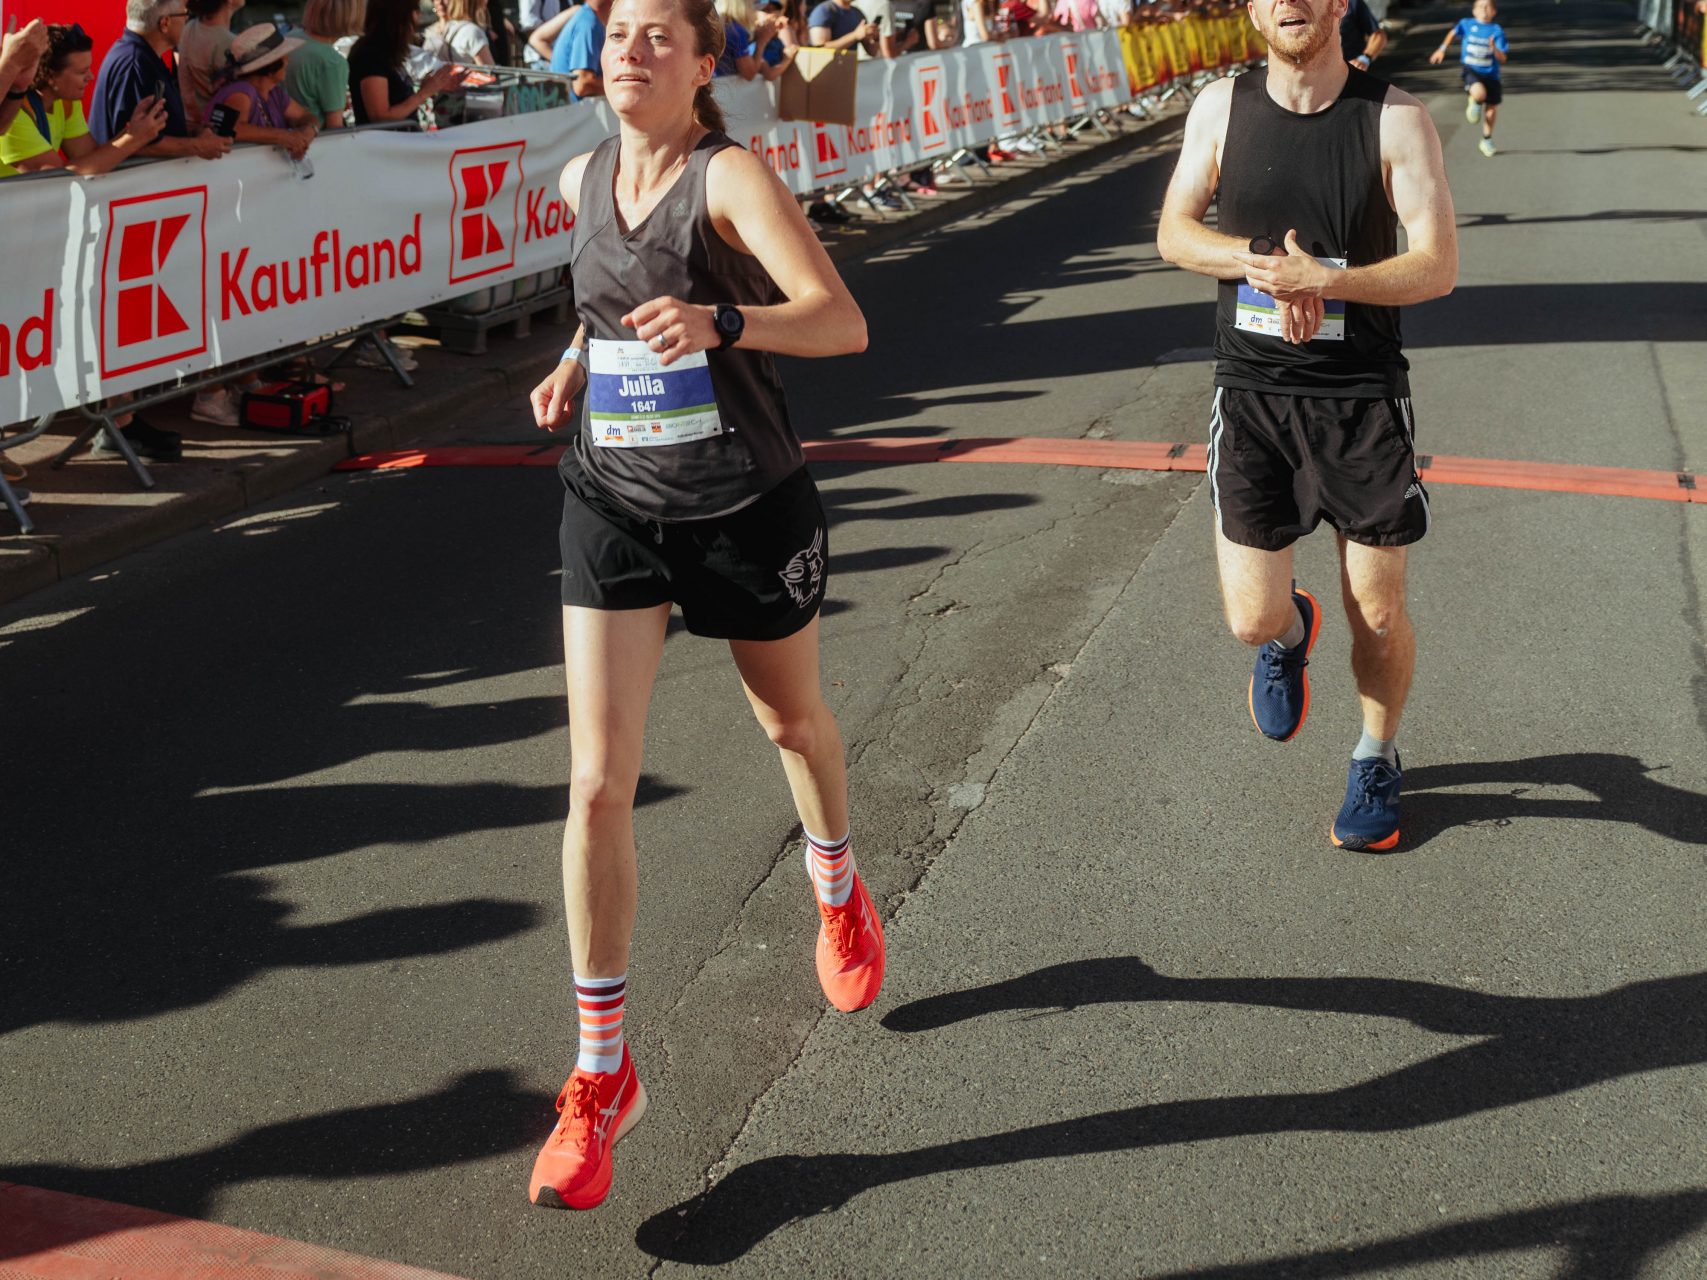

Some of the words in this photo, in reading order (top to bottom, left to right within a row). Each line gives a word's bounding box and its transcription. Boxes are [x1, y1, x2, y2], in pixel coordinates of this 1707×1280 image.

[846, 105, 912, 156] Kaufland
[220, 213, 422, 321] Kaufland
[618, 375, 665, 397] Julia
[631, 400, 657, 412] 1647
[606, 425, 621, 436] dm
